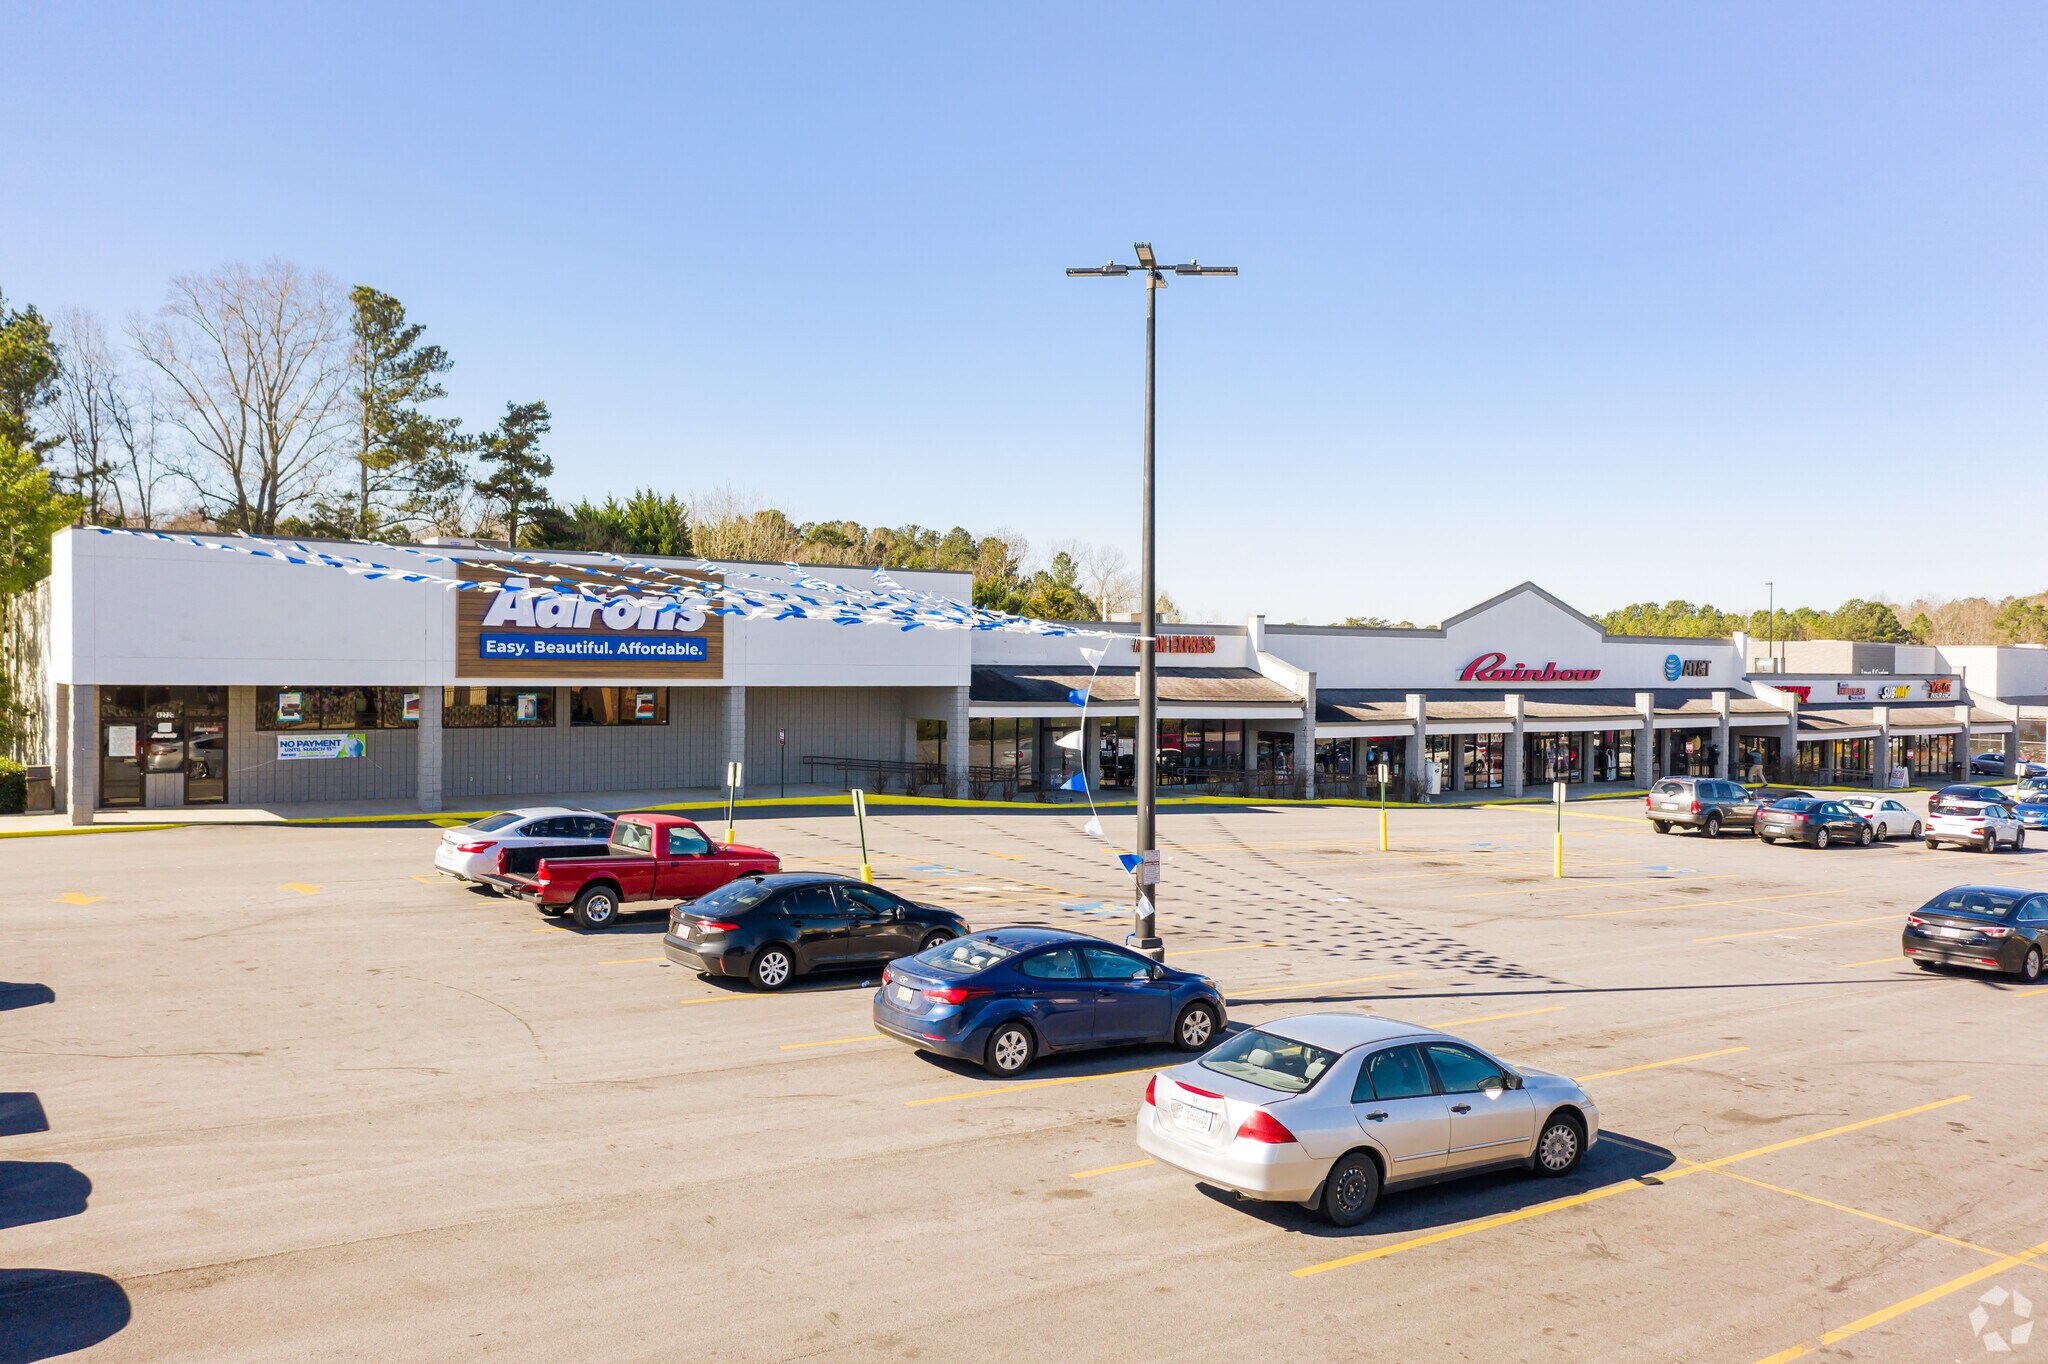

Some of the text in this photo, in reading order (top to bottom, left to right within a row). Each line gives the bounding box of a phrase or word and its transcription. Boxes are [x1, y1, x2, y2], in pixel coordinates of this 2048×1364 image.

[481, 577, 707, 632] Aaron's
[486, 640, 703, 657] Easy. Beautiful. Affordable.
[1132, 634, 1216, 654] AAN EXPRESS
[1459, 652, 1602, 682] Rainbow
[1681, 660, 1712, 677] AT&T
[1880, 685, 1911, 699] SUBWAY
[280, 739, 342, 748] NO PAYMENT
